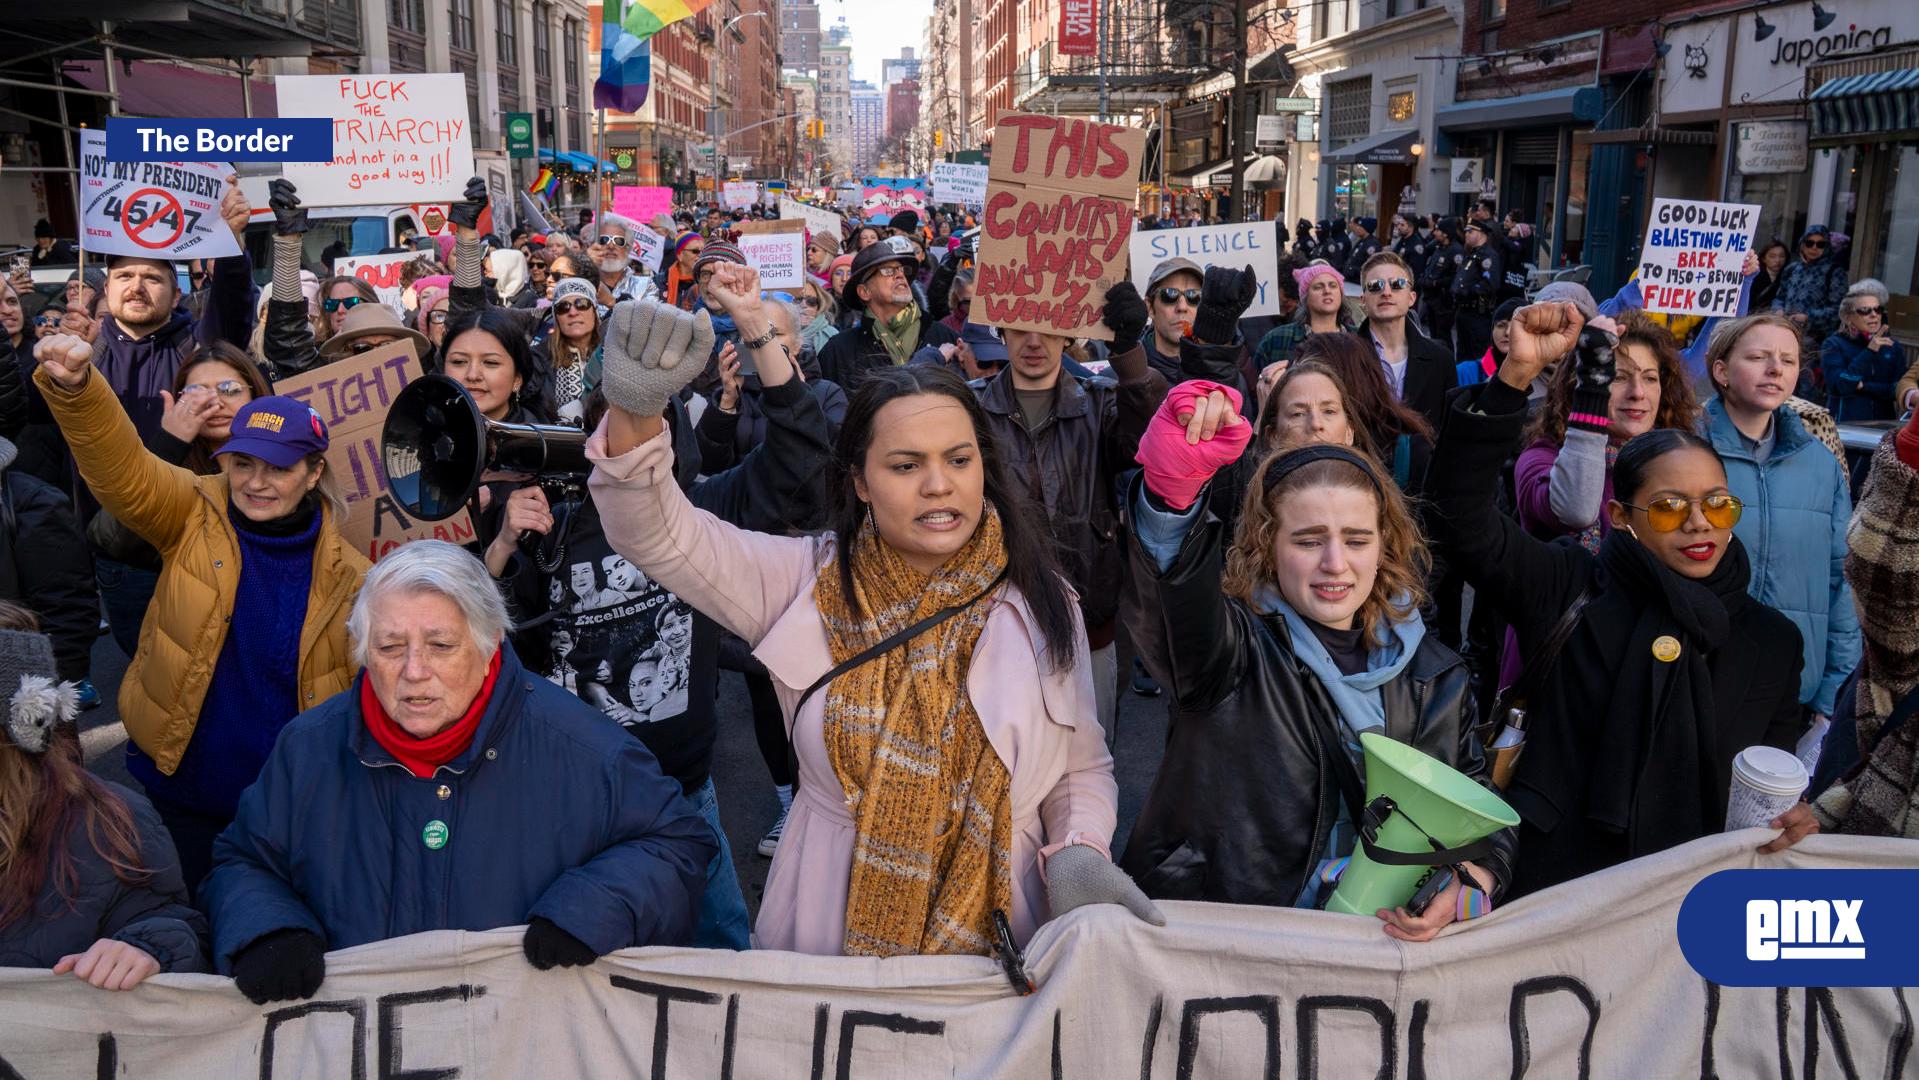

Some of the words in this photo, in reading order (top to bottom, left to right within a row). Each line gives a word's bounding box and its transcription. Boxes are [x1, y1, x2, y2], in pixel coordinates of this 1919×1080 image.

[1066, 1, 1079, 36] THE
[1770, 24, 1891, 68] Japonica
[340, 78, 409, 101] FUCK
[354, 102, 386, 116] THE
[333, 118, 463, 144] TRIARCHY
[362, 150, 385, 163] not
[393, 150, 409, 163] in
[410, 154, 419, 162] a
[998, 115, 1129, 179] THIS
[84, 154, 109, 177] NOT
[113, 161, 140, 181] MY
[142, 163, 221, 200] PRESIDENT
[348, 168, 390, 189] good
[398, 169, 426, 184] way
[935, 165, 957, 175] STOP
[960, 166, 988, 178] TRUM
[104, 196, 202, 233] 45/47
[880, 198, 907, 208] With
[985, 191, 1134, 262] COUNTRY
[1659, 204, 1707, 224] GOOD
[1710, 206, 1749, 230] LUCK
[1151, 230, 1260, 258] SILENCE
[1651, 228, 1723, 250] BLASTING
[1726, 233, 1748, 252] ME
[760, 254, 792, 262] RIGHTS
[1027, 234, 1108, 279] WAS
[1677, 251, 1718, 268] BACK
[760, 269, 792, 278] RIGHTS
[1643, 263, 1663, 279] TO
[1666, 268, 1694, 284] 1950
[1708, 269, 1744, 285] BEYOND
[985, 295, 1104, 329] WOMEN
[1642, 285, 1696, 310] FUCK
[1698, 287, 1740, 313] OFF!
[575, 593, 665, 626] Excellence
